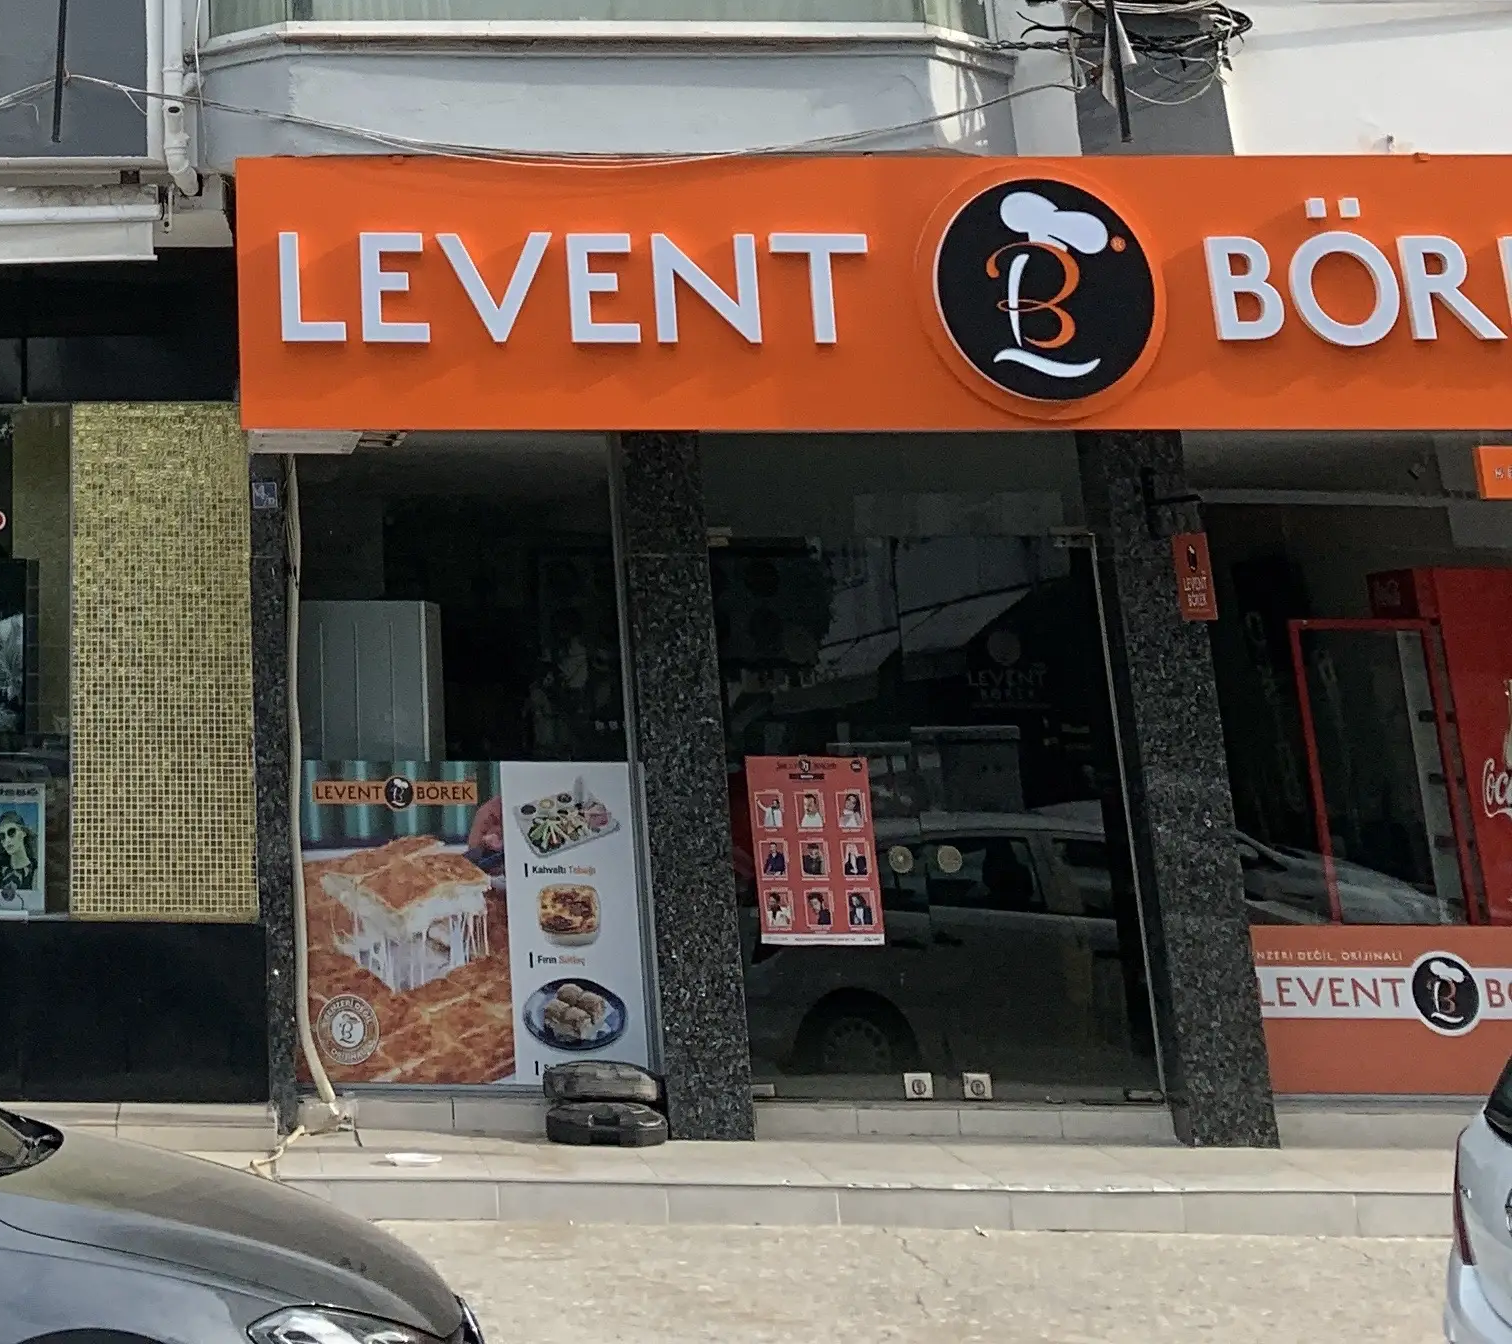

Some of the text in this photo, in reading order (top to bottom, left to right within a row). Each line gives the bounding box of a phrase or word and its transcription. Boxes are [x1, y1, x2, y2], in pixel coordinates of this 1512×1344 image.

[278, 197, 1512, 347] LEVENT BÖR
[315, 783, 474, 800] LEVENT BÖREK
[1257, 977, 1512, 1008] LEVENT B
